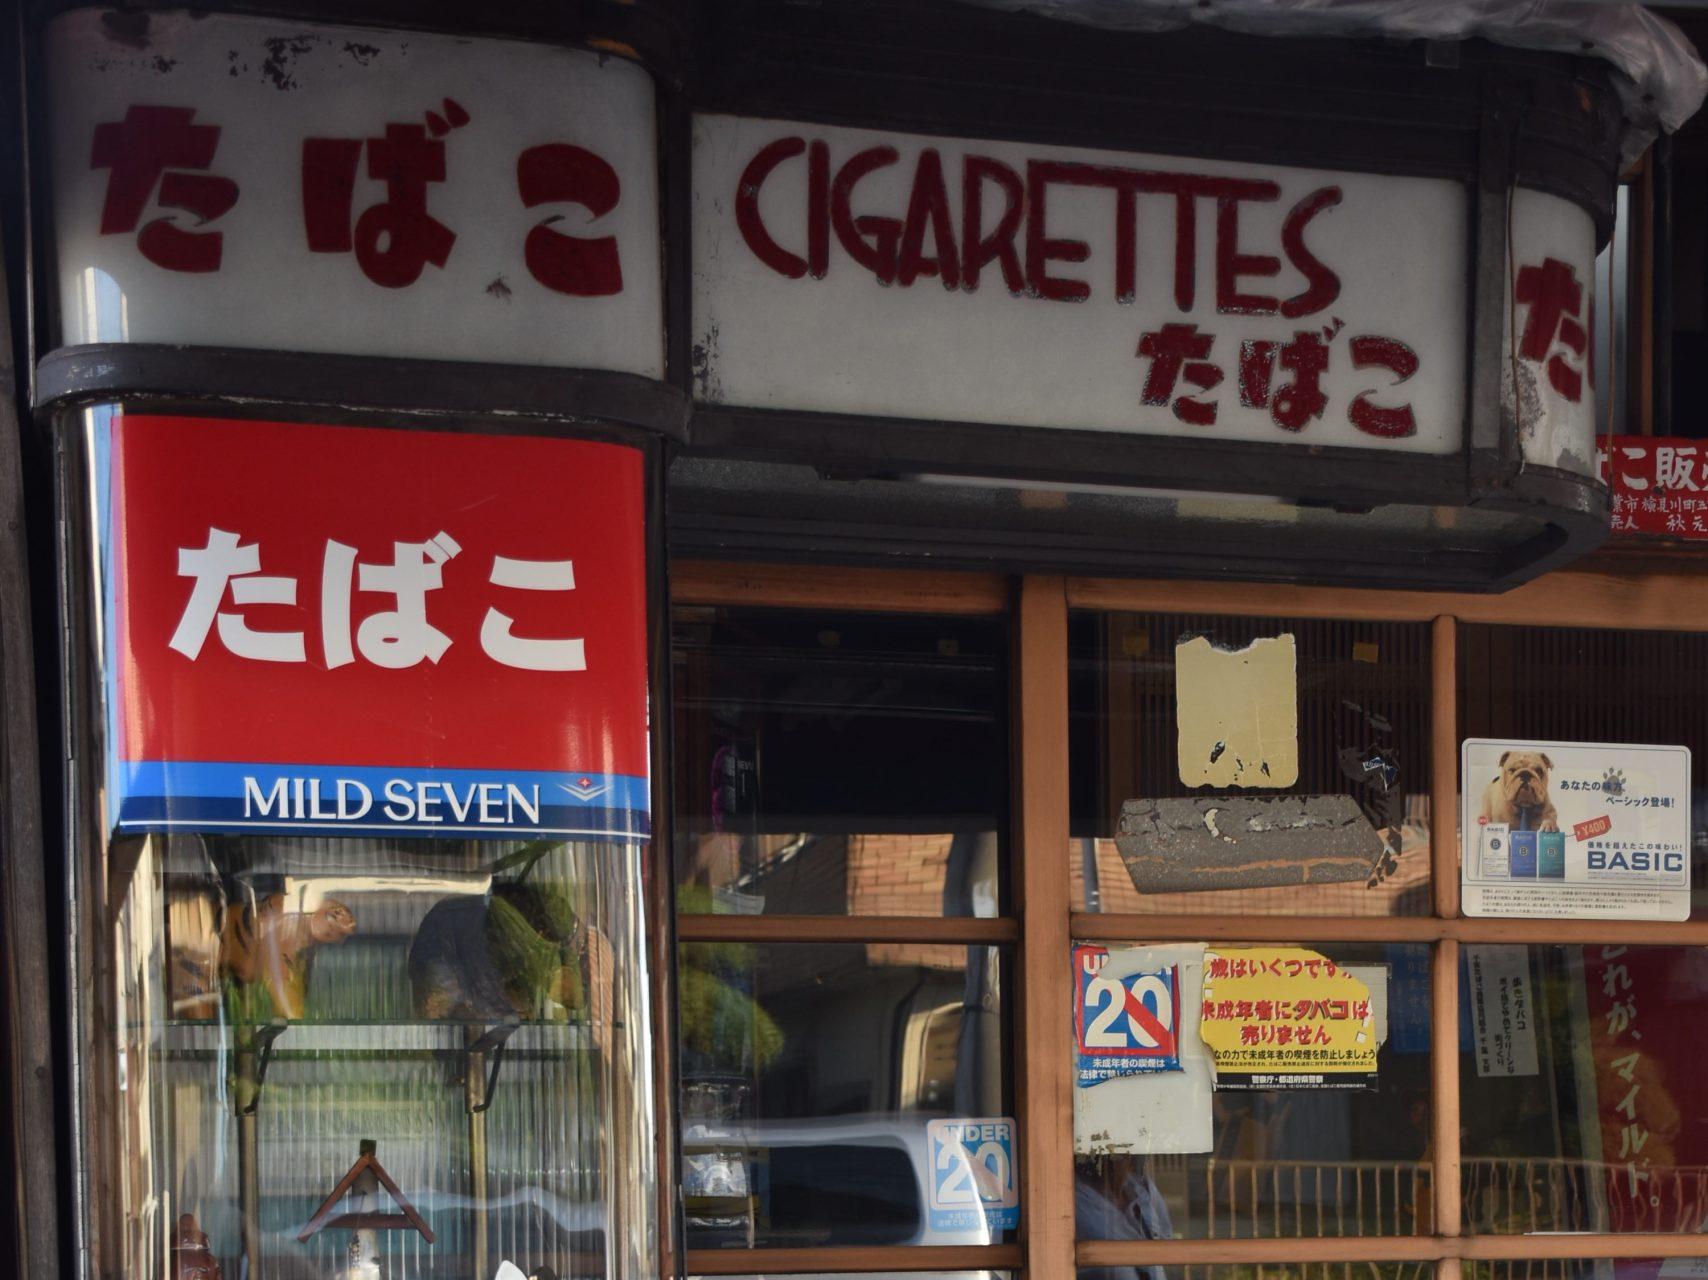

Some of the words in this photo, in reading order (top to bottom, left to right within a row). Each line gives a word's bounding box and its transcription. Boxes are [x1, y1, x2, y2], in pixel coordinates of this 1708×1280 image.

[90, 98, 623, 297] たばこ
[735, 135, 1343, 318] CIGARETTES
[1514, 257, 1595, 404] た
[1136, 316, 1420, 439] たばこ
[1596, 446, 1708, 491] こ販
[168, 526, 588, 671] たばこ
[243, 776, 373, 821] MILD
[383, 779, 540, 826] SEVEN
[1587, 850, 1683, 872] BASIC
[1210, 957, 1352, 979] 歳はいくつです
[1084, 975, 1172, 1049] 20
[1202, 999, 1369, 1021] 未成年者にタバコは
[1240, 1024, 1332, 1046] 売りません
[937, 1141, 1010, 1203] 20
